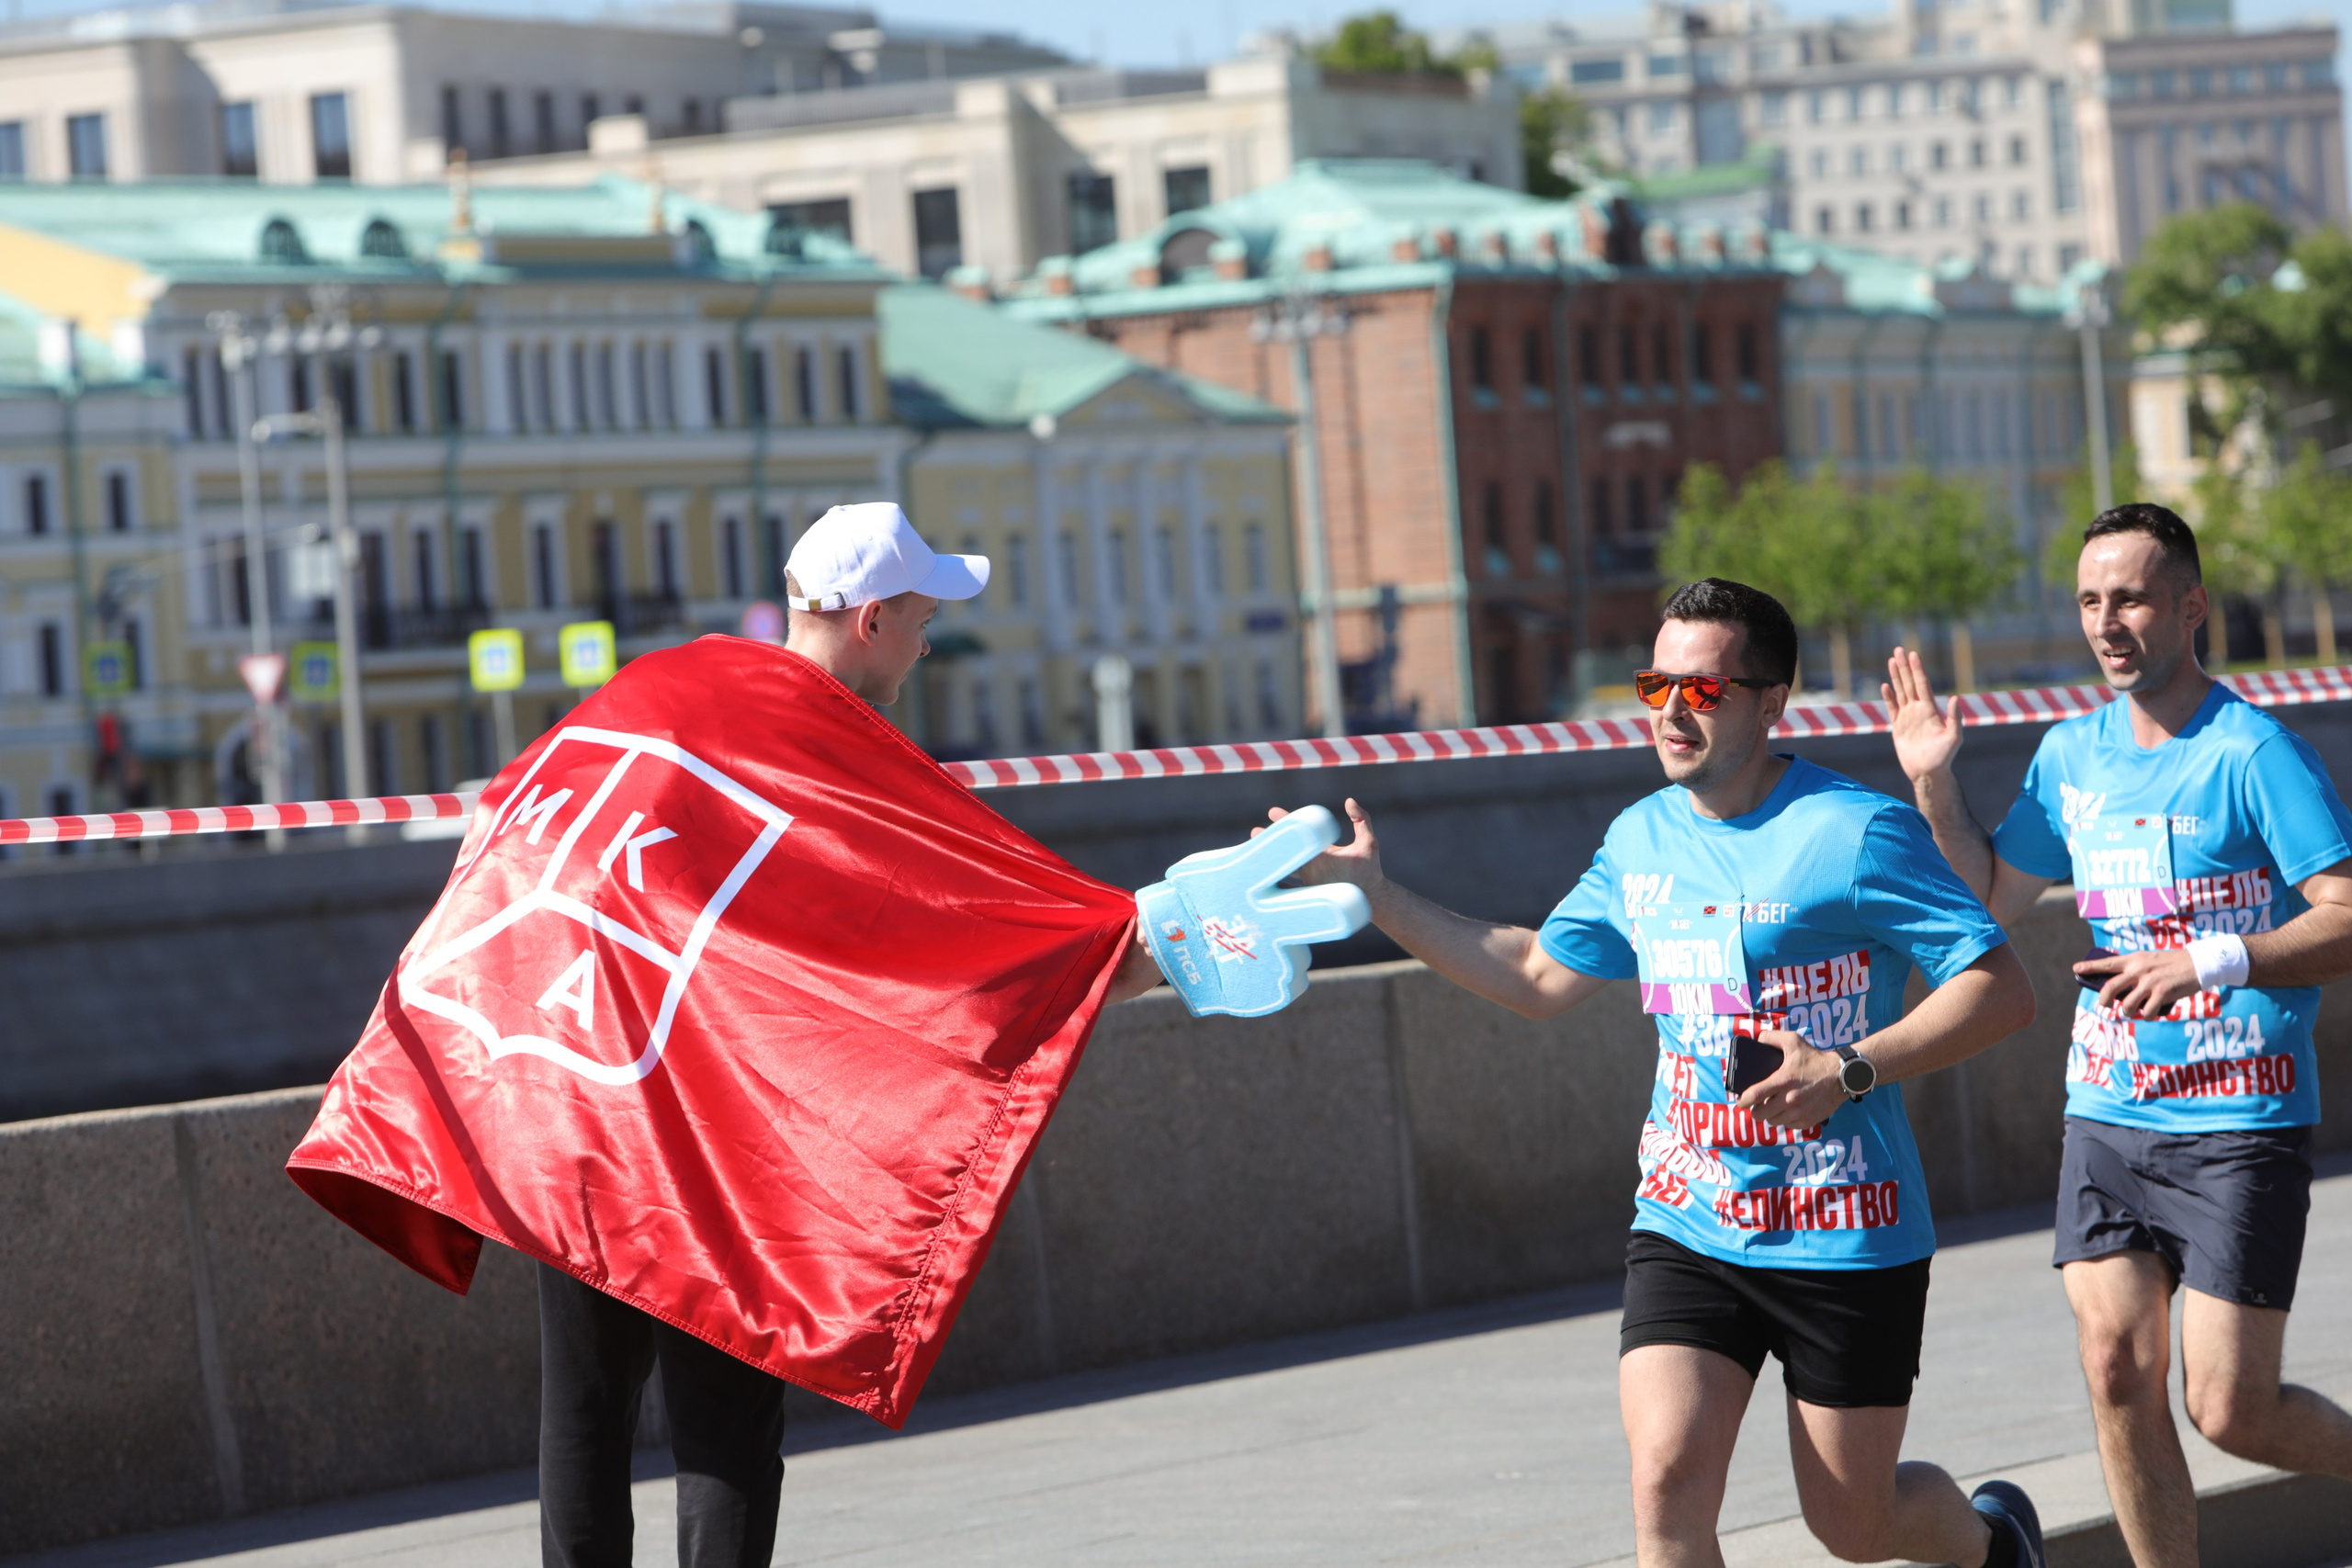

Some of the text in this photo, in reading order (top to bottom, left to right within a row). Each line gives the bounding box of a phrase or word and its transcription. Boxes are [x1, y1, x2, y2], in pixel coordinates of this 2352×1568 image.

[2088, 848, 2152, 886] 32772
[2157, 865, 2166, 879] D
[1173, 946, 1204, 986] ПСБ
[1652, 939, 1723, 978] 30576
[1760, 951, 1871, 1010] #ЦЕЛЬ
[536, 949, 595, 1032] А
[1727, 977, 1738, 991] D
[2185, 1014, 2266, 1062] 2024
[2132, 1054, 2295, 1099] #ЕДИНСТВО
[1783, 1135, 1868, 1185] 2024
[1713, 1180, 1899, 1230] #ЕДИНСТВО
